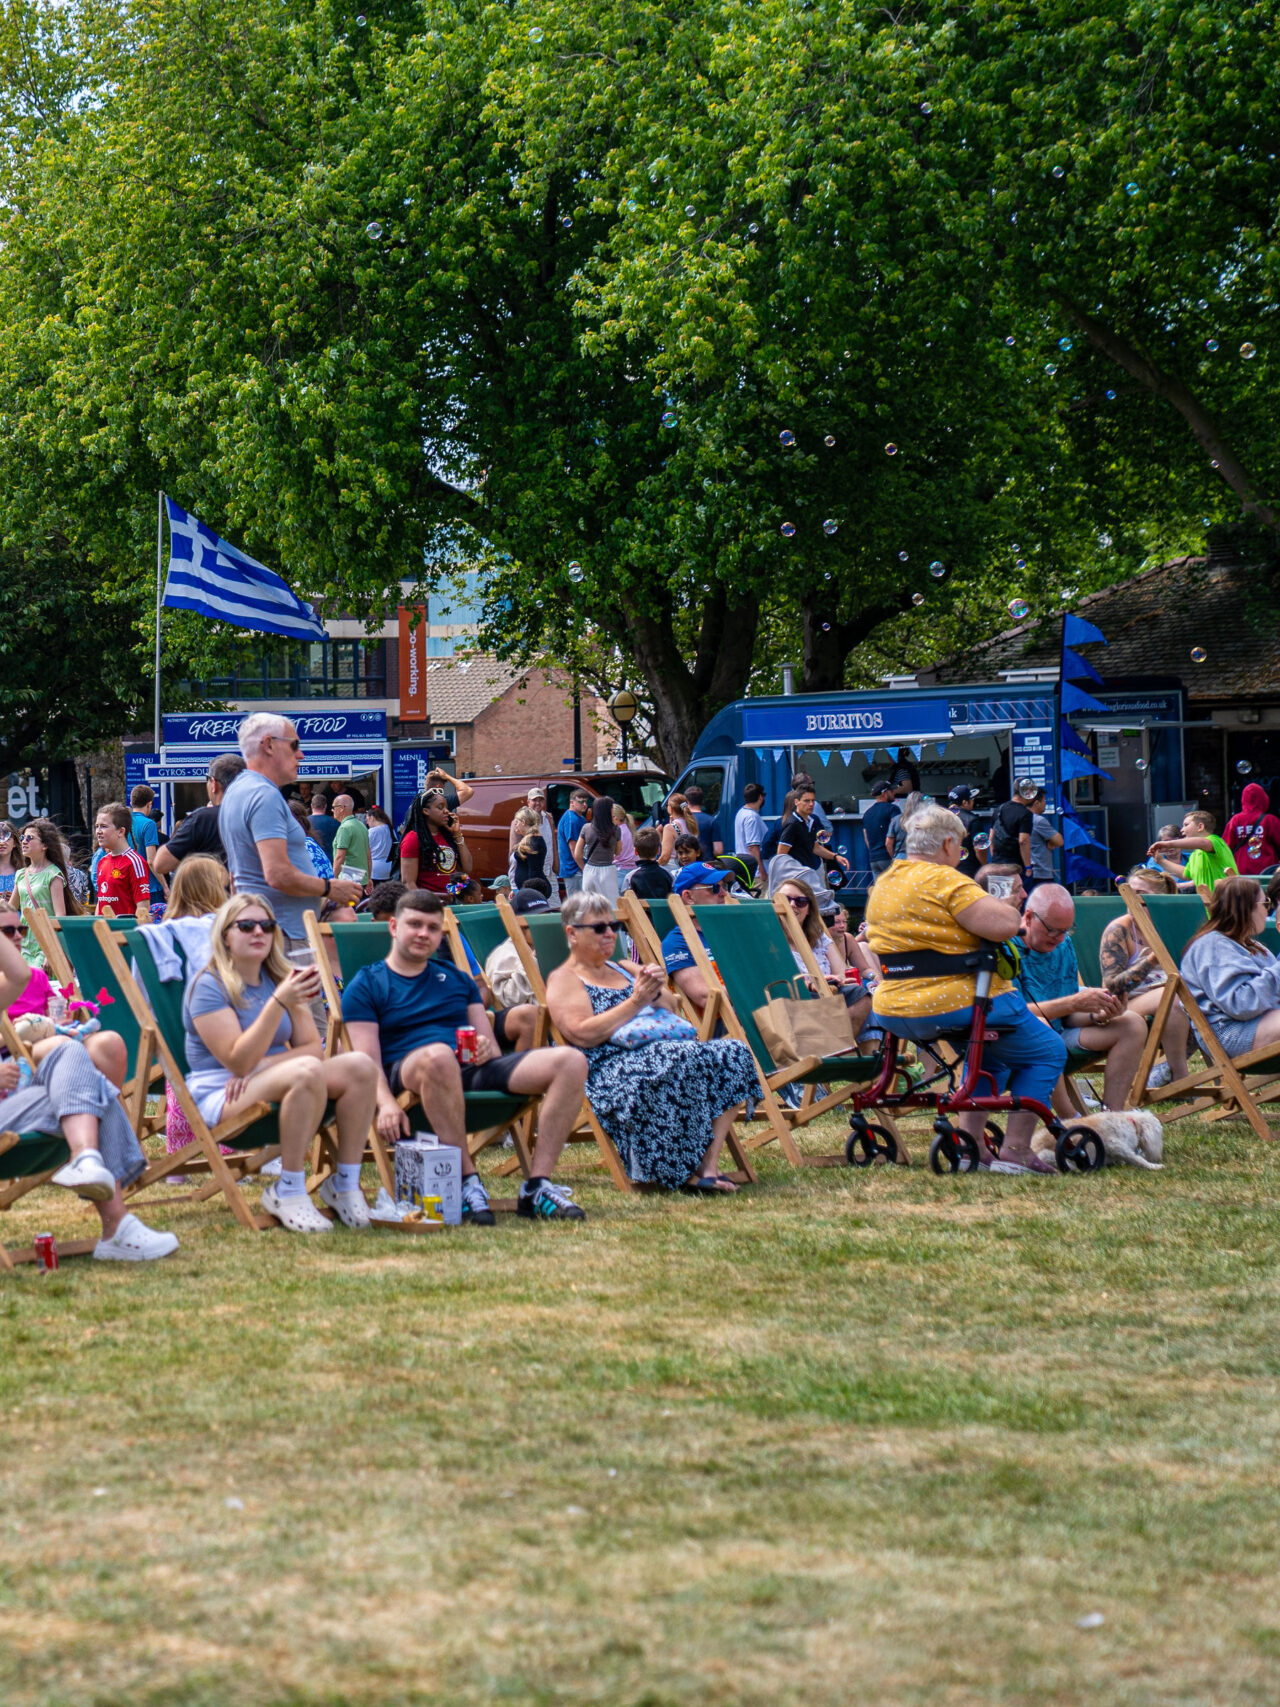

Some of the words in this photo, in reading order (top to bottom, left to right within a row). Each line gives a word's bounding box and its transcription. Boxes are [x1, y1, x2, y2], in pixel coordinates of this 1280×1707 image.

[188, 719, 241, 740] GREEK
[304, 716, 347, 734] FOOD
[806, 712, 883, 731] BURRITOS
[132, 757, 154, 765] MENU
[158, 768, 186, 776] GYROS
[316, 766, 340, 774] PITTA
